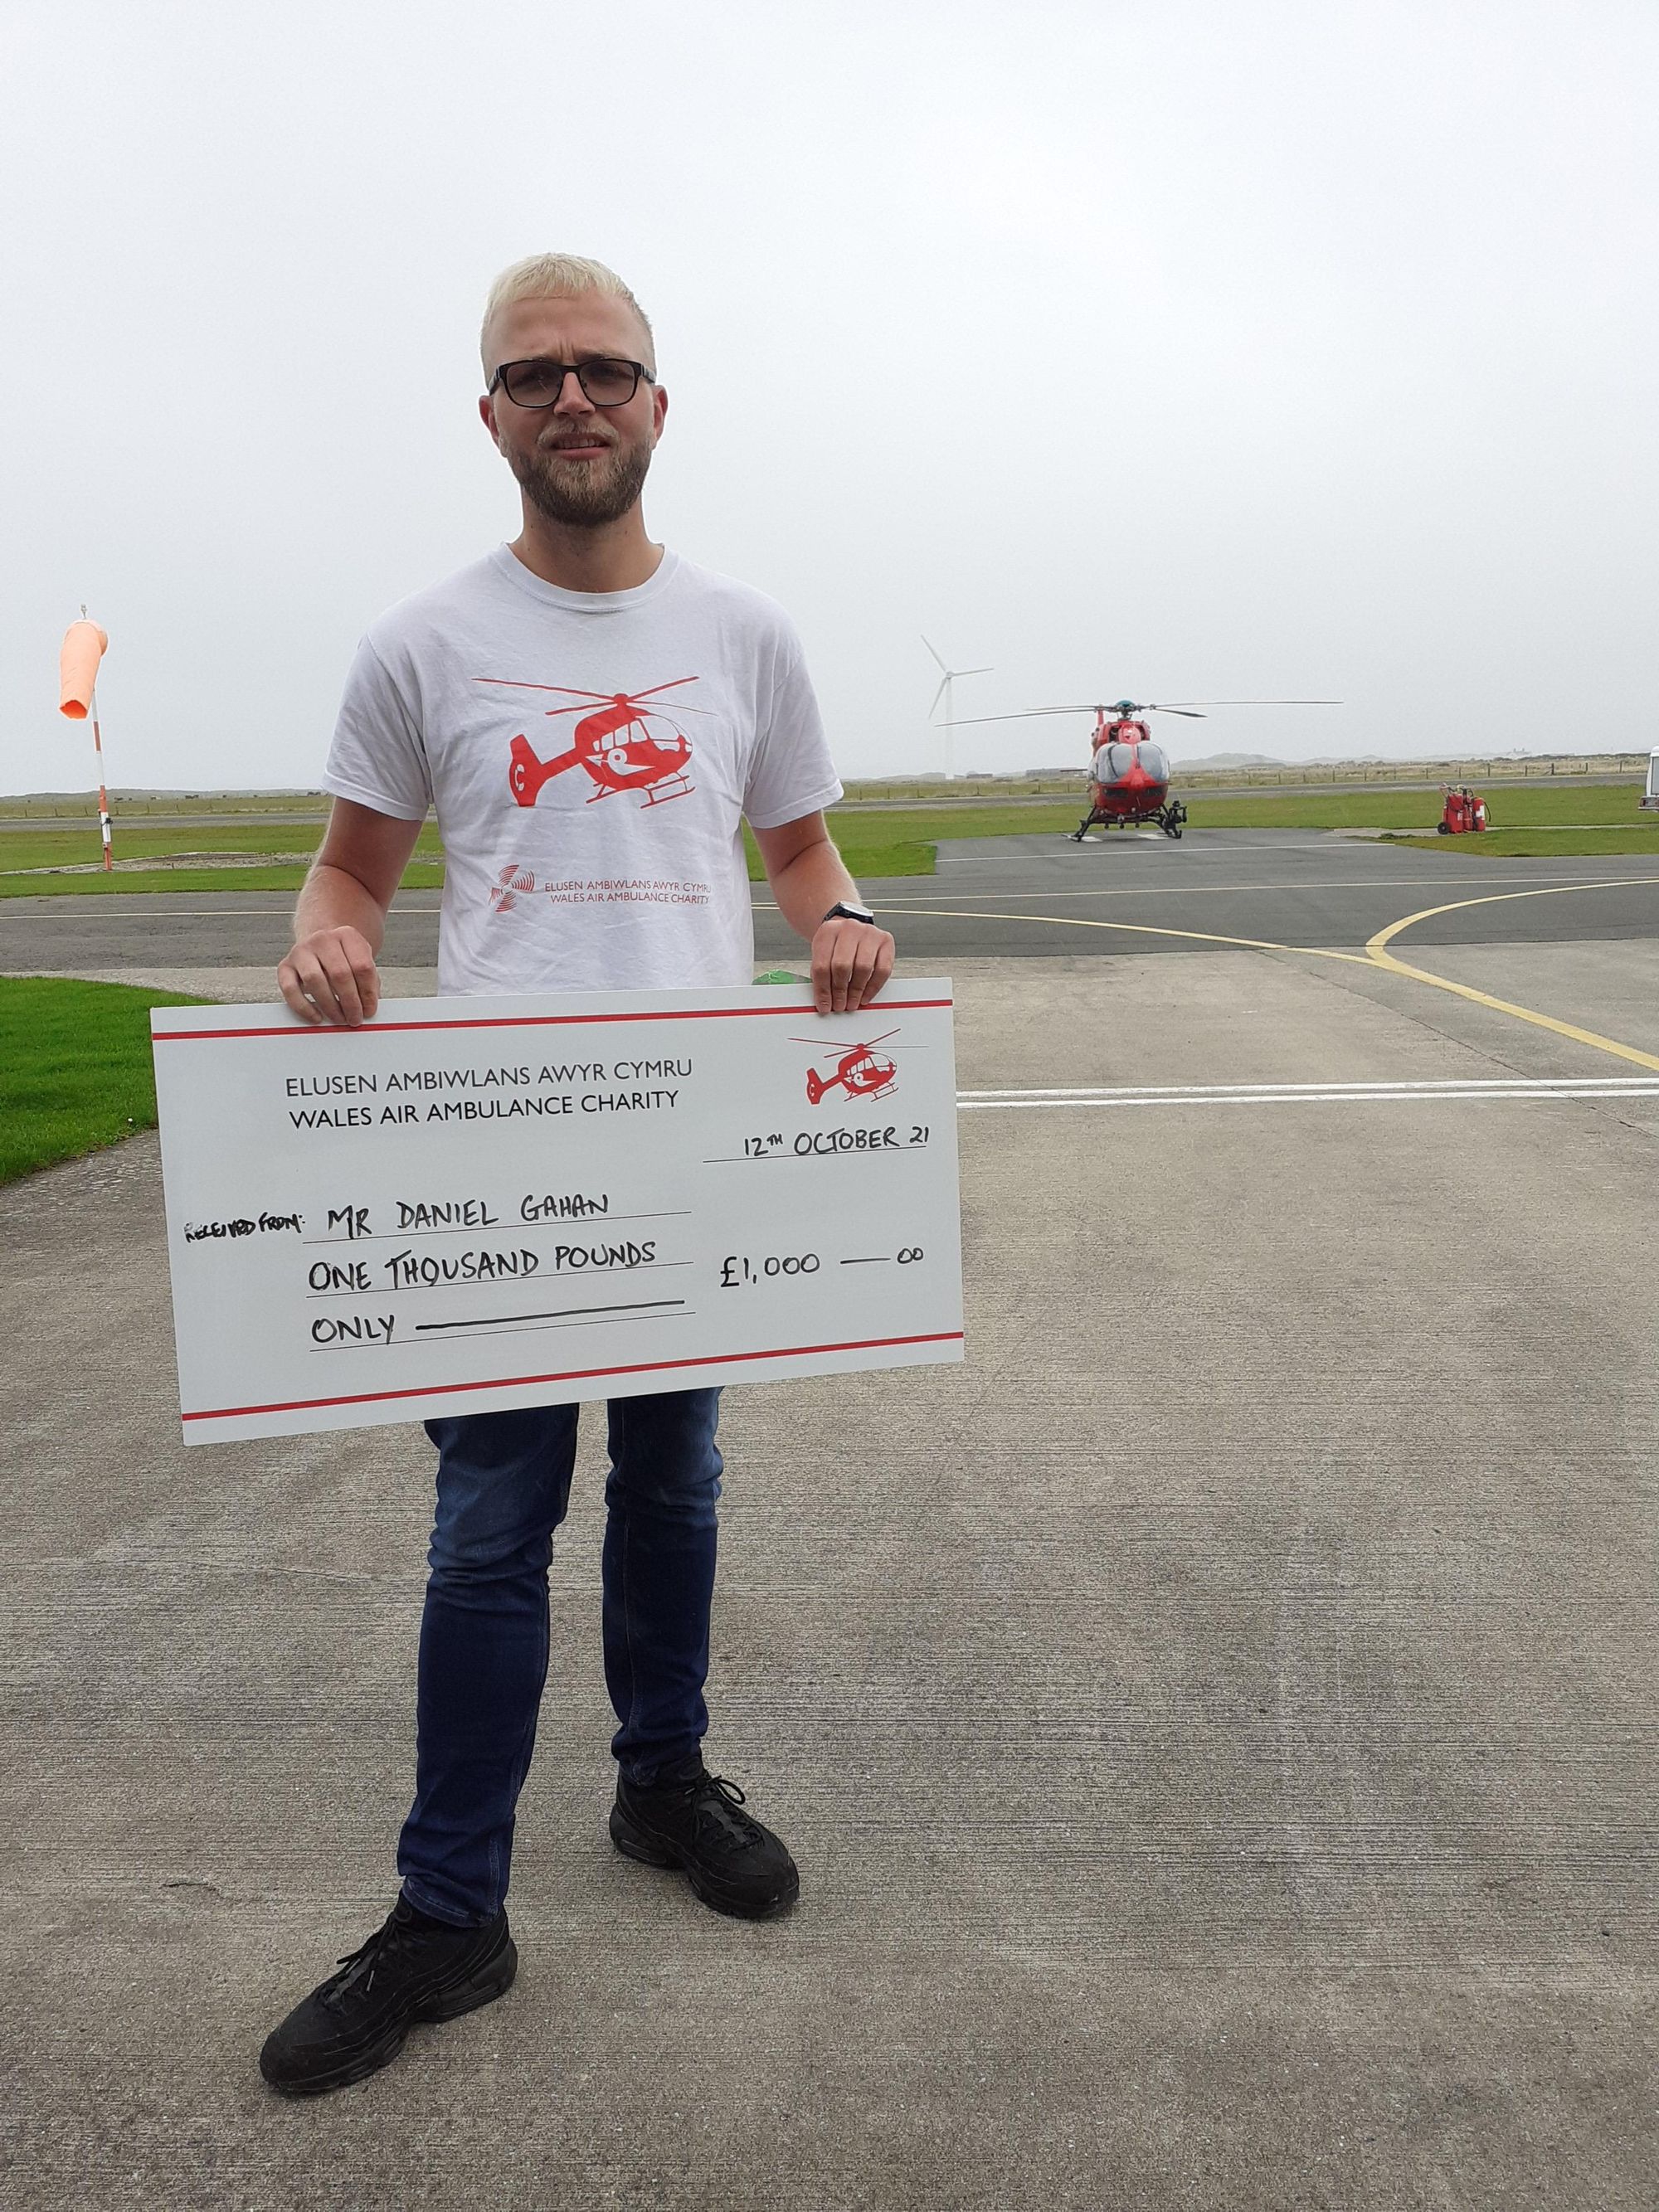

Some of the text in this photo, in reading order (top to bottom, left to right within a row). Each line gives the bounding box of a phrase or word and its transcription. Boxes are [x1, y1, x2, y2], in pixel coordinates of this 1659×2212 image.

[545, 881, 583, 892] ELUSEN
[587, 880, 651, 890] AMBIWLANS
[653, 882, 679, 892] AWYR
[551, 892, 710, 904] WALES AIR AMBULANCE CHARITY
[285, 1058, 693, 1096] ELUSEN AMBIWLANS AWYR CYMRU
[289, 1089, 679, 1129] WALES AIR AMBULANCE CHARITY
[794, 1127, 900, 1155] OCTOBER
[909, 1126, 929, 1144] 21
[327, 1205, 372, 1239] MR
[396, 1199, 499, 1230] DANIEL
[521, 1194, 609, 1221] GAHAN
[309, 1241, 656, 1291] ONE THOUSAND POUNDS
[720, 1253, 820, 1288] £1,000
[311, 1314, 396, 1345] ONLY
